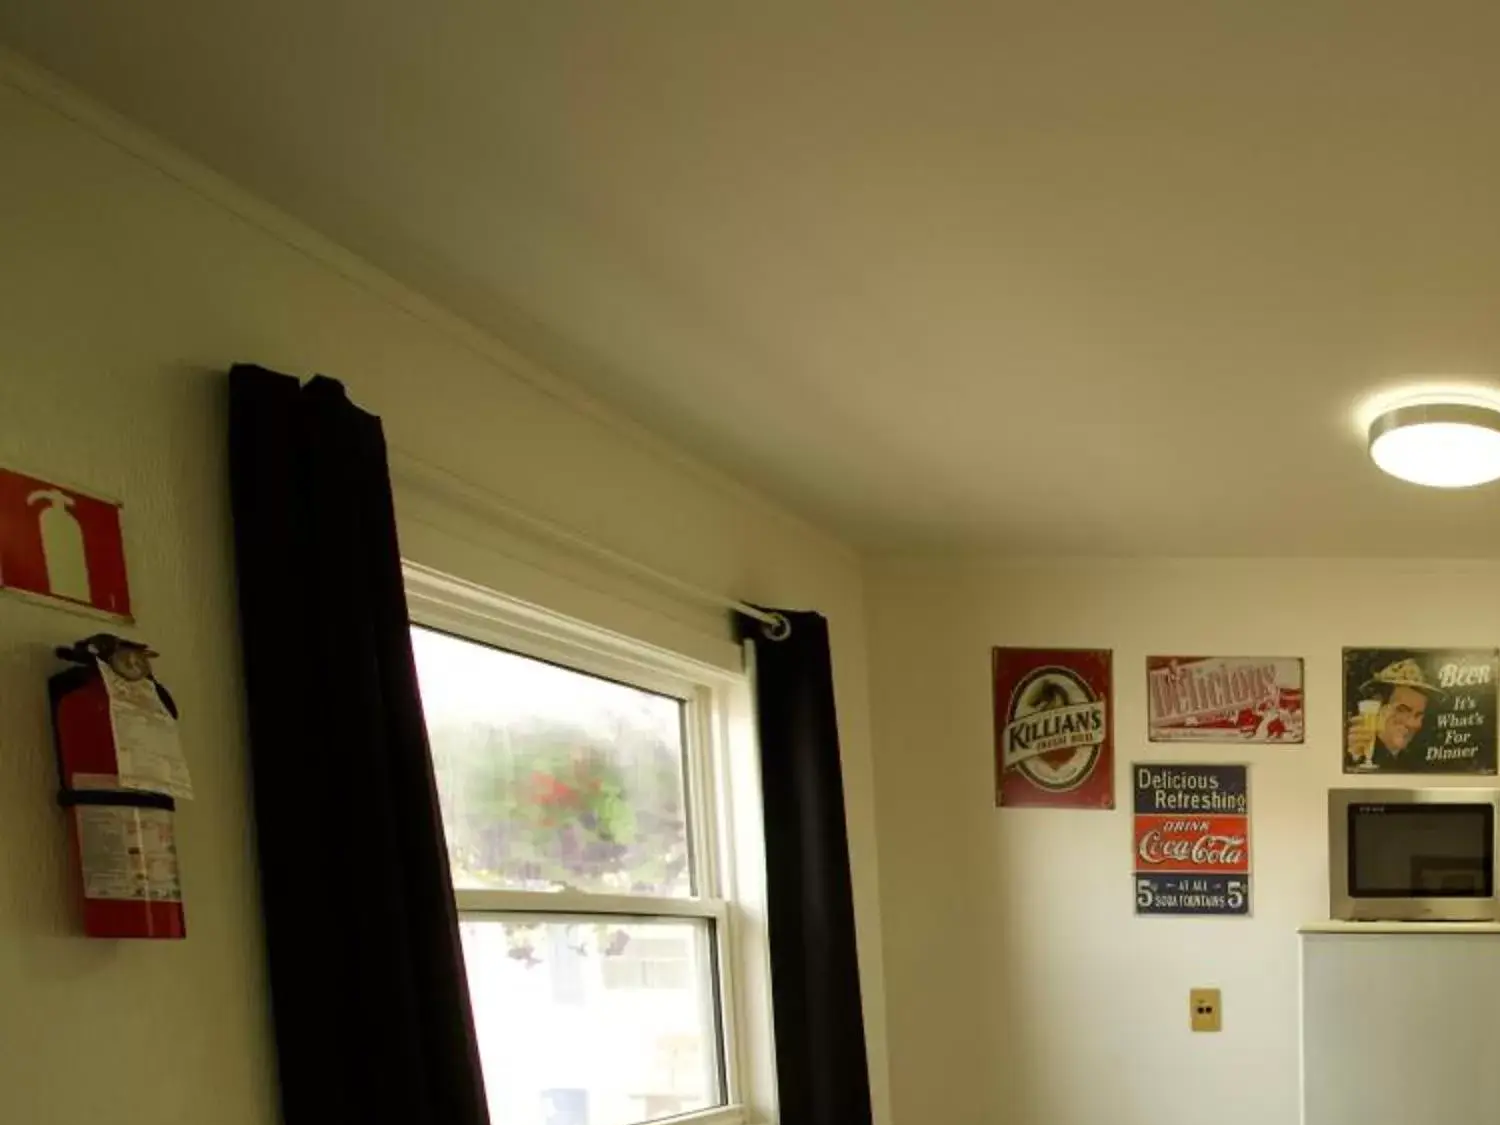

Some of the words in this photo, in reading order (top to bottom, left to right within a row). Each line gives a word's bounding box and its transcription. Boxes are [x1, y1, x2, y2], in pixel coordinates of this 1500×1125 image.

[1454, 696, 1476, 710] It's
[1437, 712, 1485, 728] What's
[1444, 729, 1472, 745] For
[1425, 745, 1479, 761] Dinner
[1138, 768, 1220, 790] Delicious
[1154, 789, 1246, 813] Refreshing
